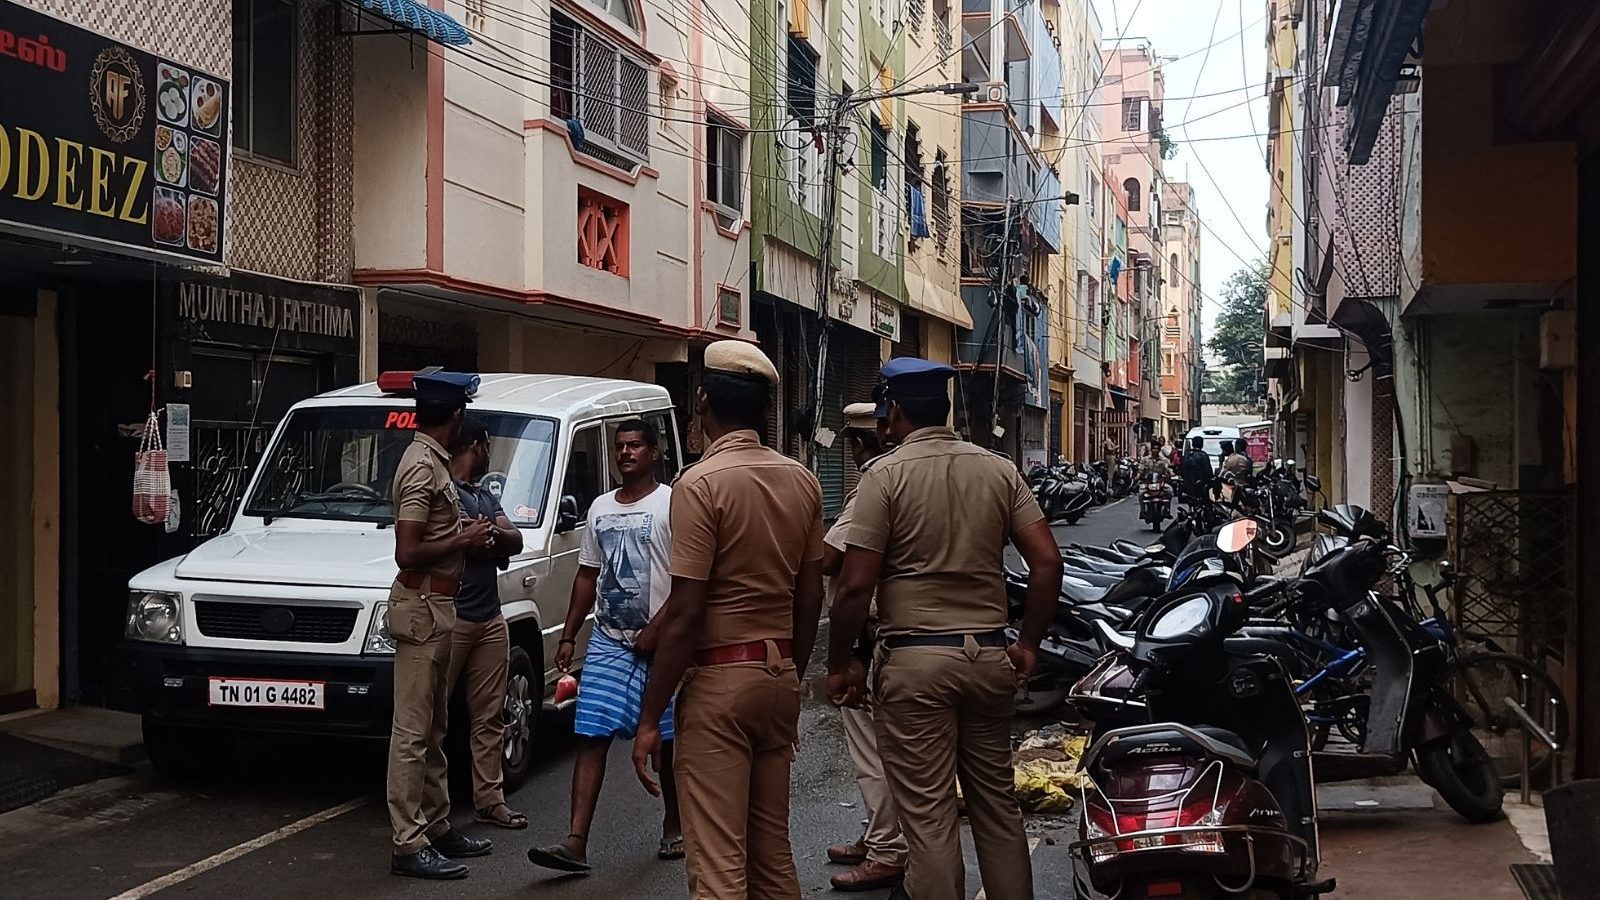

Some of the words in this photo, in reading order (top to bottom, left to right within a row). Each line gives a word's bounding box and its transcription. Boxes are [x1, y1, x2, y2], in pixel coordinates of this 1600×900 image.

[179, 282, 276, 329] MUMTHAJ
[281, 297, 354, 339] FATHIMA
[385, 411, 418, 429] POL
[220, 685, 239, 702] TN
[244, 685, 260, 703] 01
[266, 686, 276, 703] G
[281, 687, 316, 706] 4482
